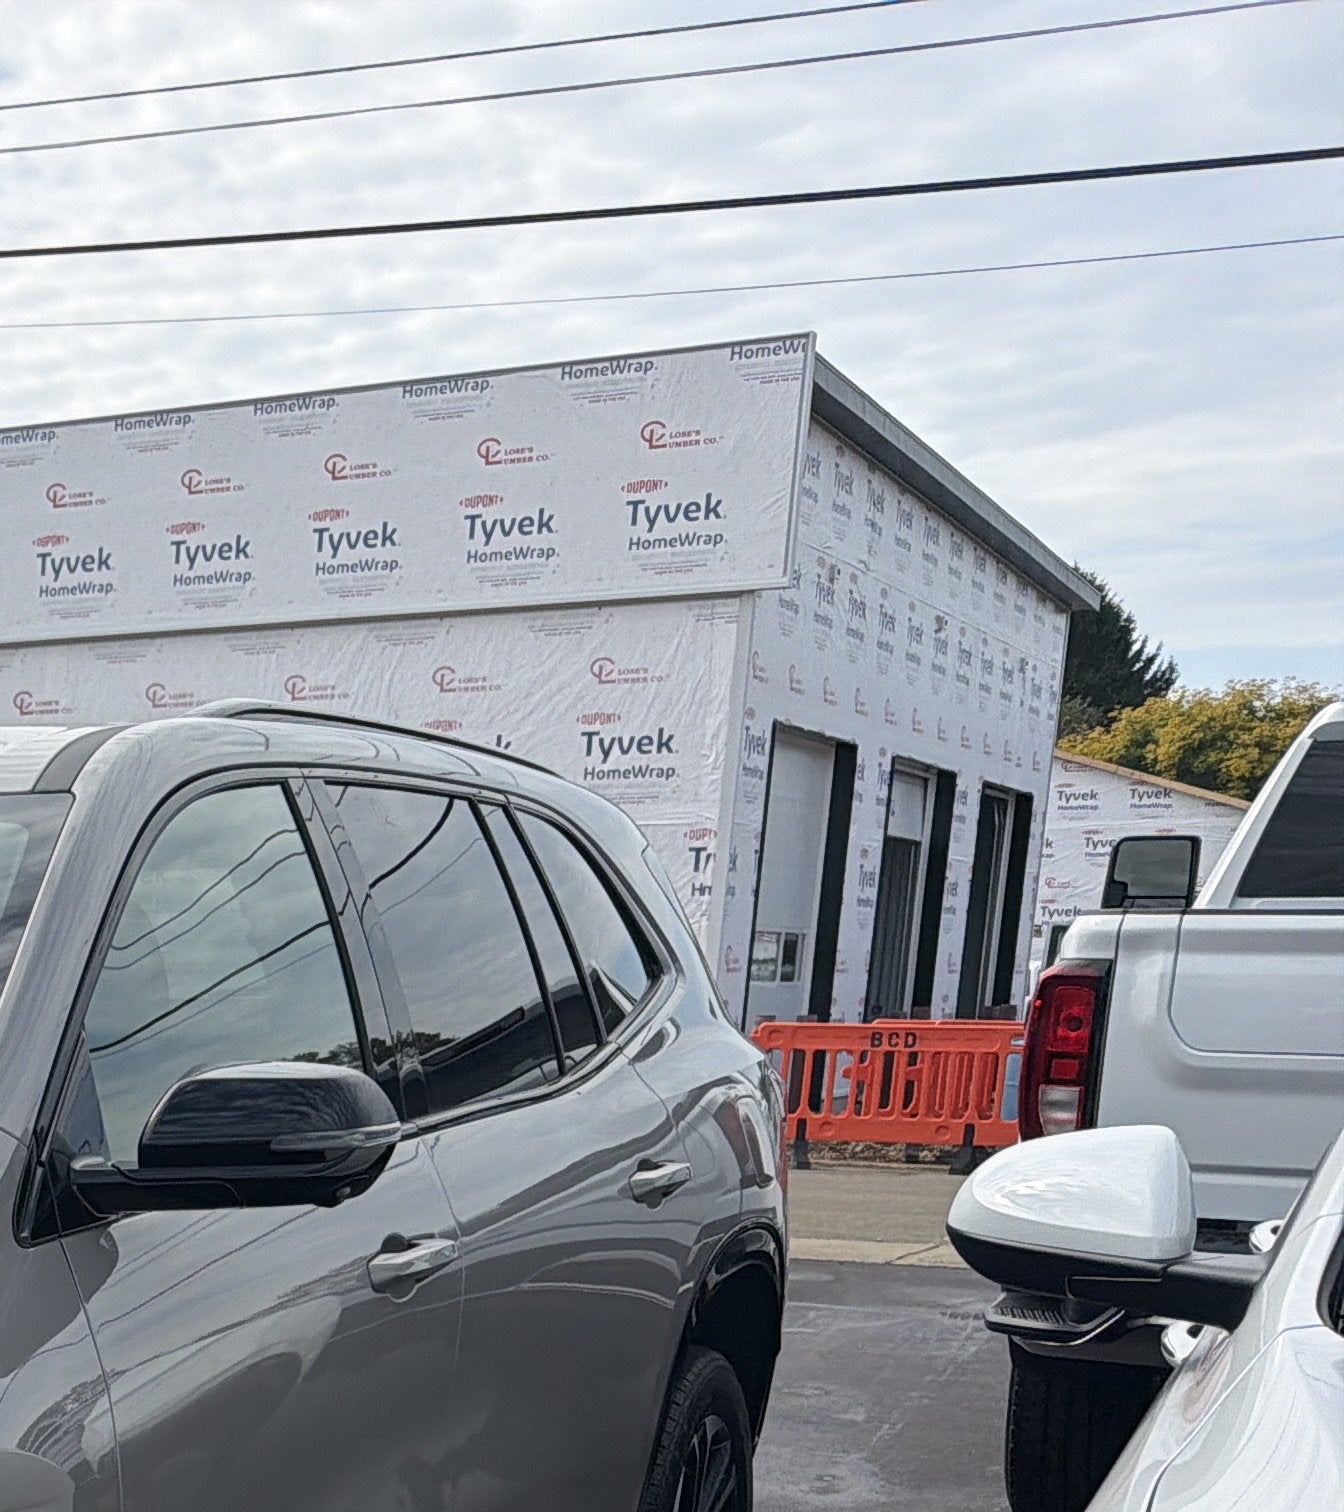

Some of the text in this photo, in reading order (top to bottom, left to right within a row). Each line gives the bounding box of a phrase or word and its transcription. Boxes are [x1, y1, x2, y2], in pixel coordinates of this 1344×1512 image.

[561, 358, 658, 381] HomeWrap
[402, 379, 493, 400] HomeWrap
[254, 397, 339, 416] HomeWrap
[114, 413, 194, 432] HomeWrap
[626, 479, 664, 494] DUPONT
[463, 496, 499, 508] DUPONT
[626, 493, 722, 533] Tyvek
[464, 507, 555, 546] Tyvek
[313, 522, 397, 558] Tyvek
[629, 533, 725, 551] HomeWrap
[171, 535, 250, 570] Tyvek
[467, 546, 556, 564] HomeWrap
[37, 547, 112, 582] Tyvek
[316, 558, 400, 576] HomeWrap
[173, 569, 253, 587] HomeWrap
[40, 582, 114, 598] HomeWrap
[581, 727, 674, 764] Tyvek
[584, 766, 676, 781] HomeWrap
[1057, 790, 1098, 804] Tyvek
[1130, 787, 1172, 801] Tyvek
[870, 1031, 917, 1049] BCD
